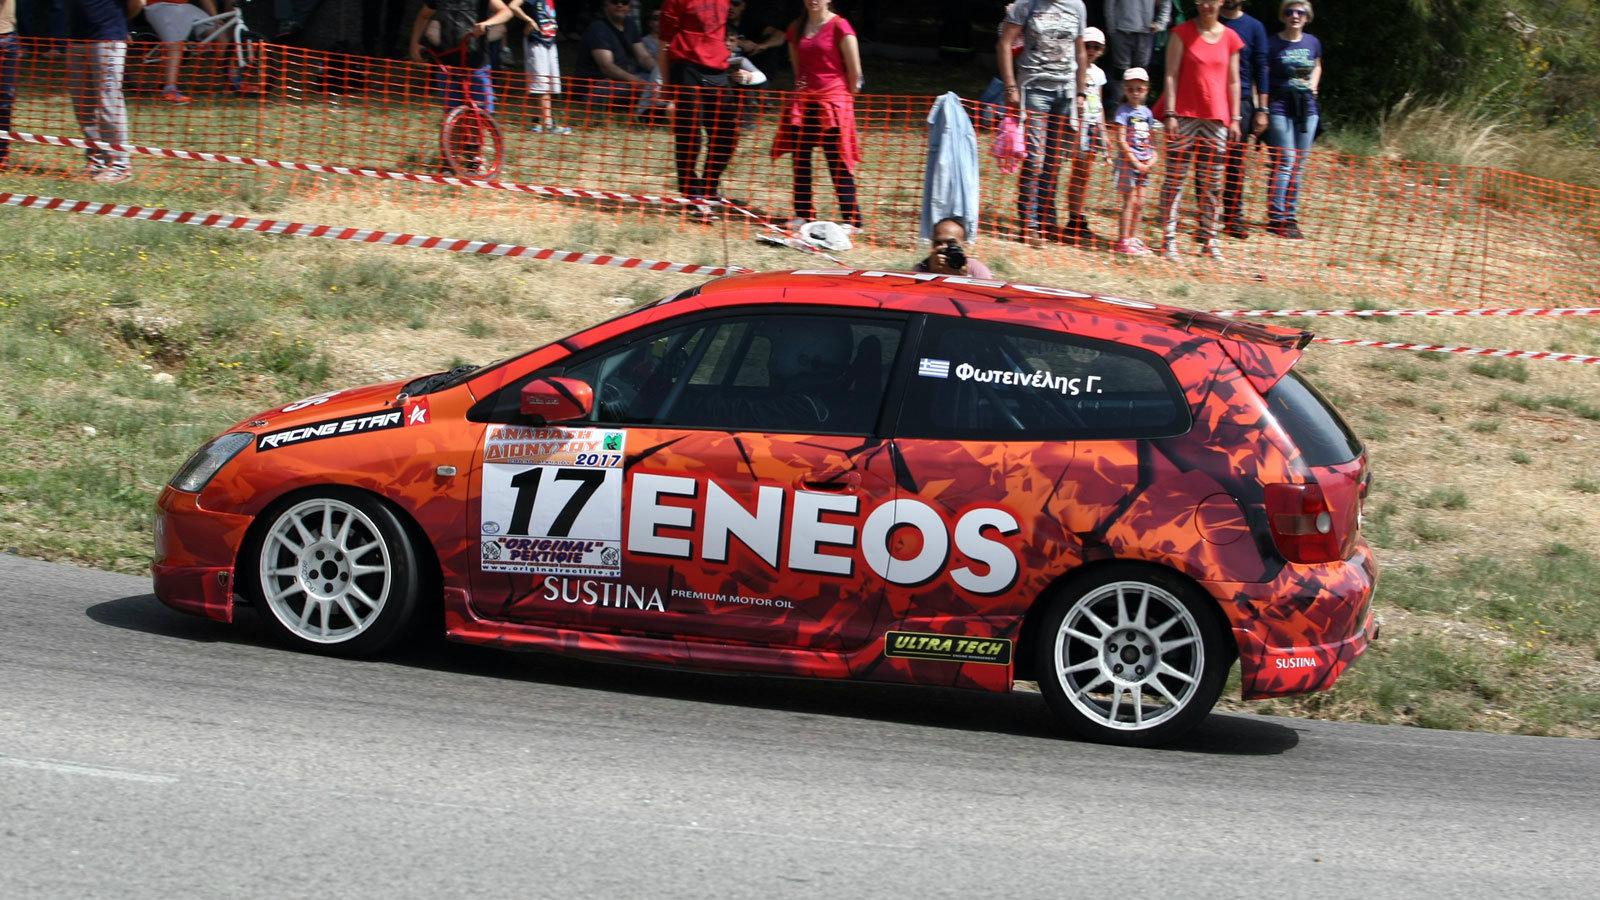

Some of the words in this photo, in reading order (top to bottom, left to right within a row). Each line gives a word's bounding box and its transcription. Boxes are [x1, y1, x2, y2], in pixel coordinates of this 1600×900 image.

[955, 363, 1081, 396] Φωτεινέλης
[1086, 375, 1103, 394] Γ.
[259, 422, 336, 448] RACING
[339, 411, 401, 433] STAR
[575, 453, 622, 467] 2017
[506, 467, 606, 537] 17
[627, 472, 1021, 595] ENEOS
[543, 576, 665, 612] SUSTINA
[671, 588, 727, 602] PREMIUM
[729, 596, 773, 607] MOTOR
[775, 599, 794, 609] OIL
[894, 636, 953, 652] ULTRA
[955, 640, 1003, 655] TECH
[1275, 657, 1317, 669] SUSTINA
